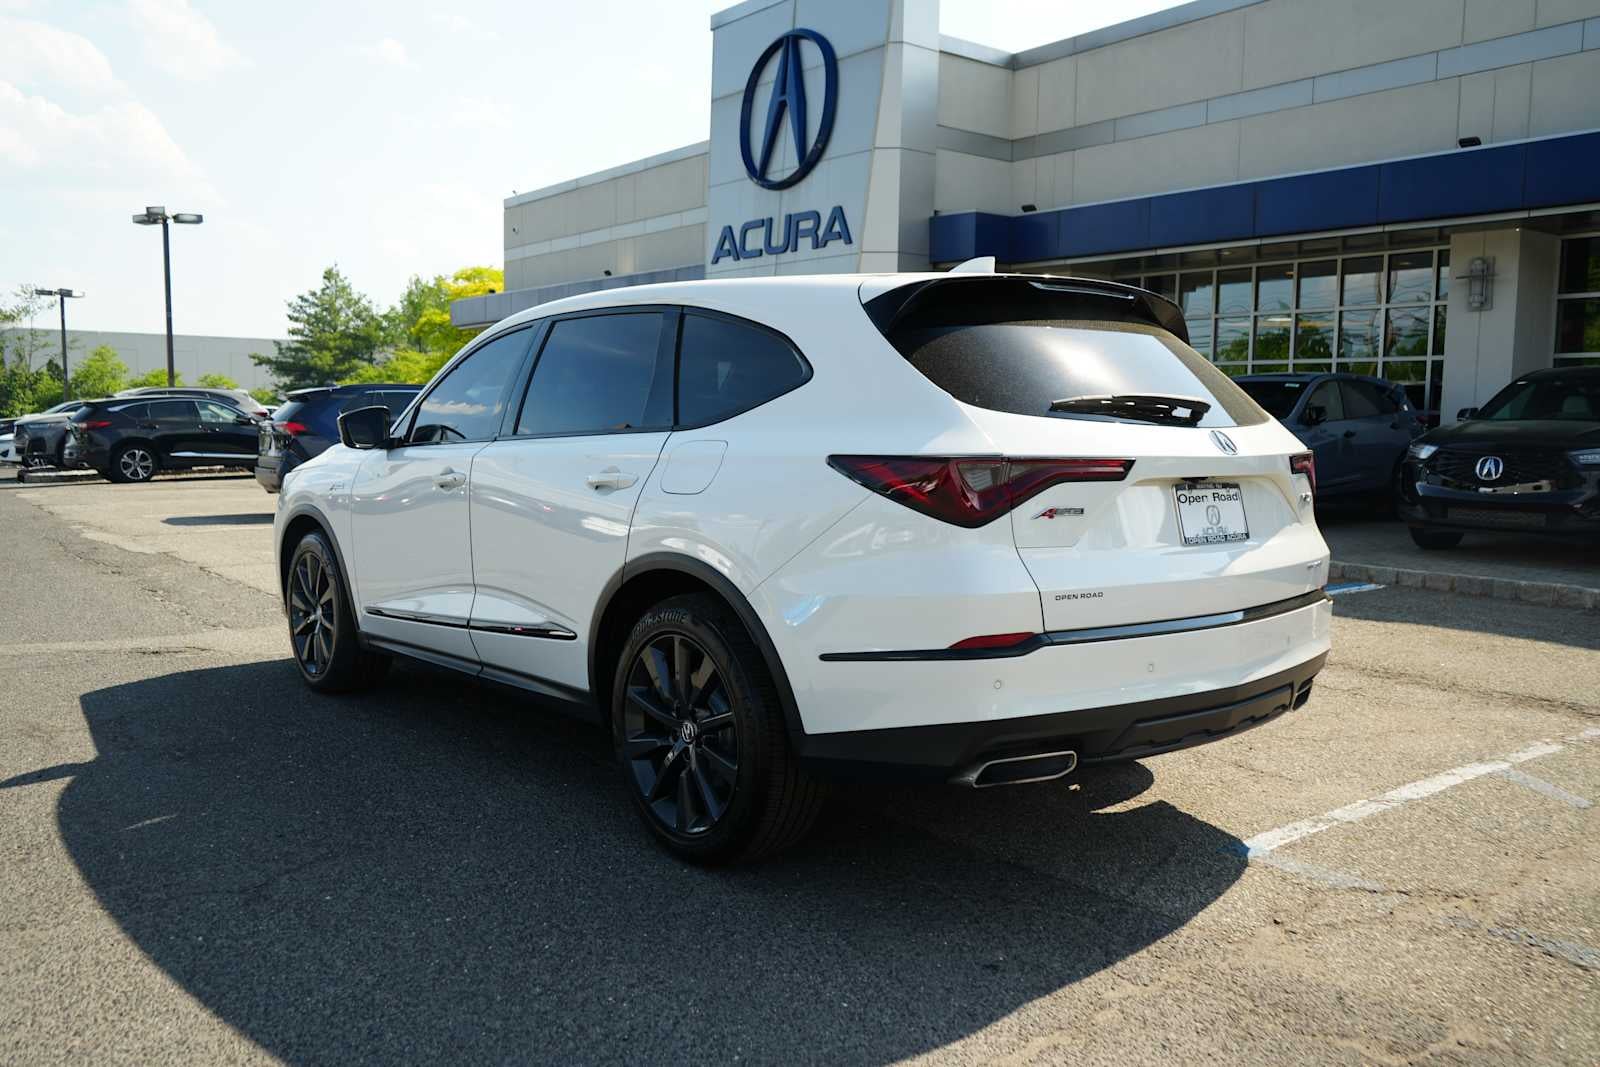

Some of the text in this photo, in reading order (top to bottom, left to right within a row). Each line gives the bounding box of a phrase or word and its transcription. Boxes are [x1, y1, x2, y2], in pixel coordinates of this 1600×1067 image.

[711, 205, 853, 264] ACURA
[1212, 492, 1239, 502] Road
[1055, 591, 1104, 601] OPEN ROAD
